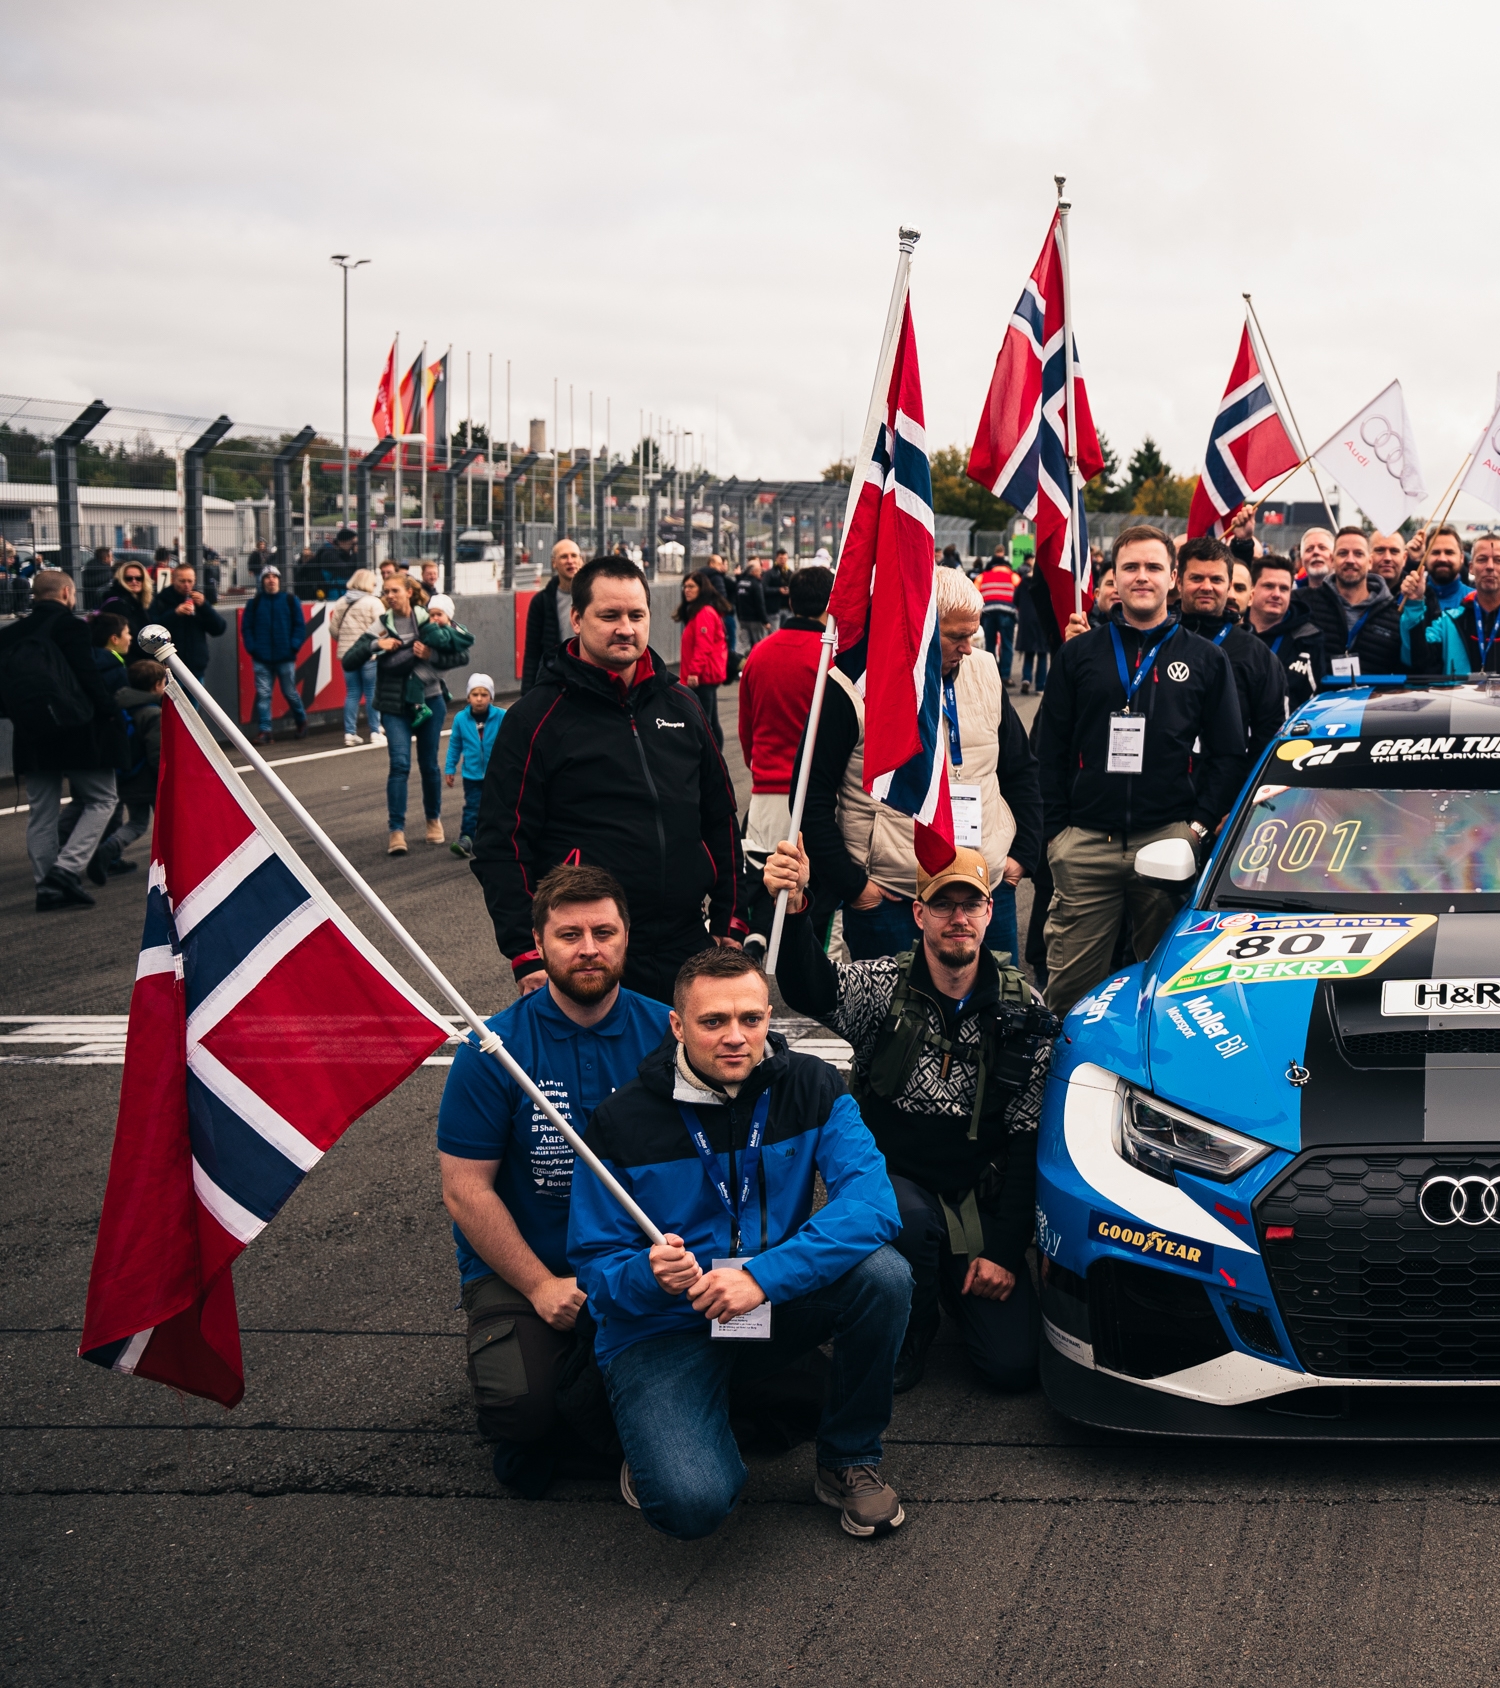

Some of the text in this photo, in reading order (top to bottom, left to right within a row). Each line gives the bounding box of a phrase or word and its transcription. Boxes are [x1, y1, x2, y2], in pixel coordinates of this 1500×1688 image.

[1344, 440, 1371, 468] Audi
[1325, 723, 1346, 736] T
[1369, 736, 1457, 757] GRAN
[1370, 755, 1399, 763] THE
[1402, 754, 1441, 762] REAL
[1239, 819, 1362, 872] 801
[1256, 917, 1401, 931] RAVENOL
[1227, 933, 1373, 959] 801
[1227, 960, 1349, 980] DEKRA
[1166, 1006, 1197, 1039] Motorsport
[1215, 1034, 1249, 1060] Bil
[540, 1134, 565, 1143] Aars
[1097, 1220, 1203, 1263] GOODYEAR
